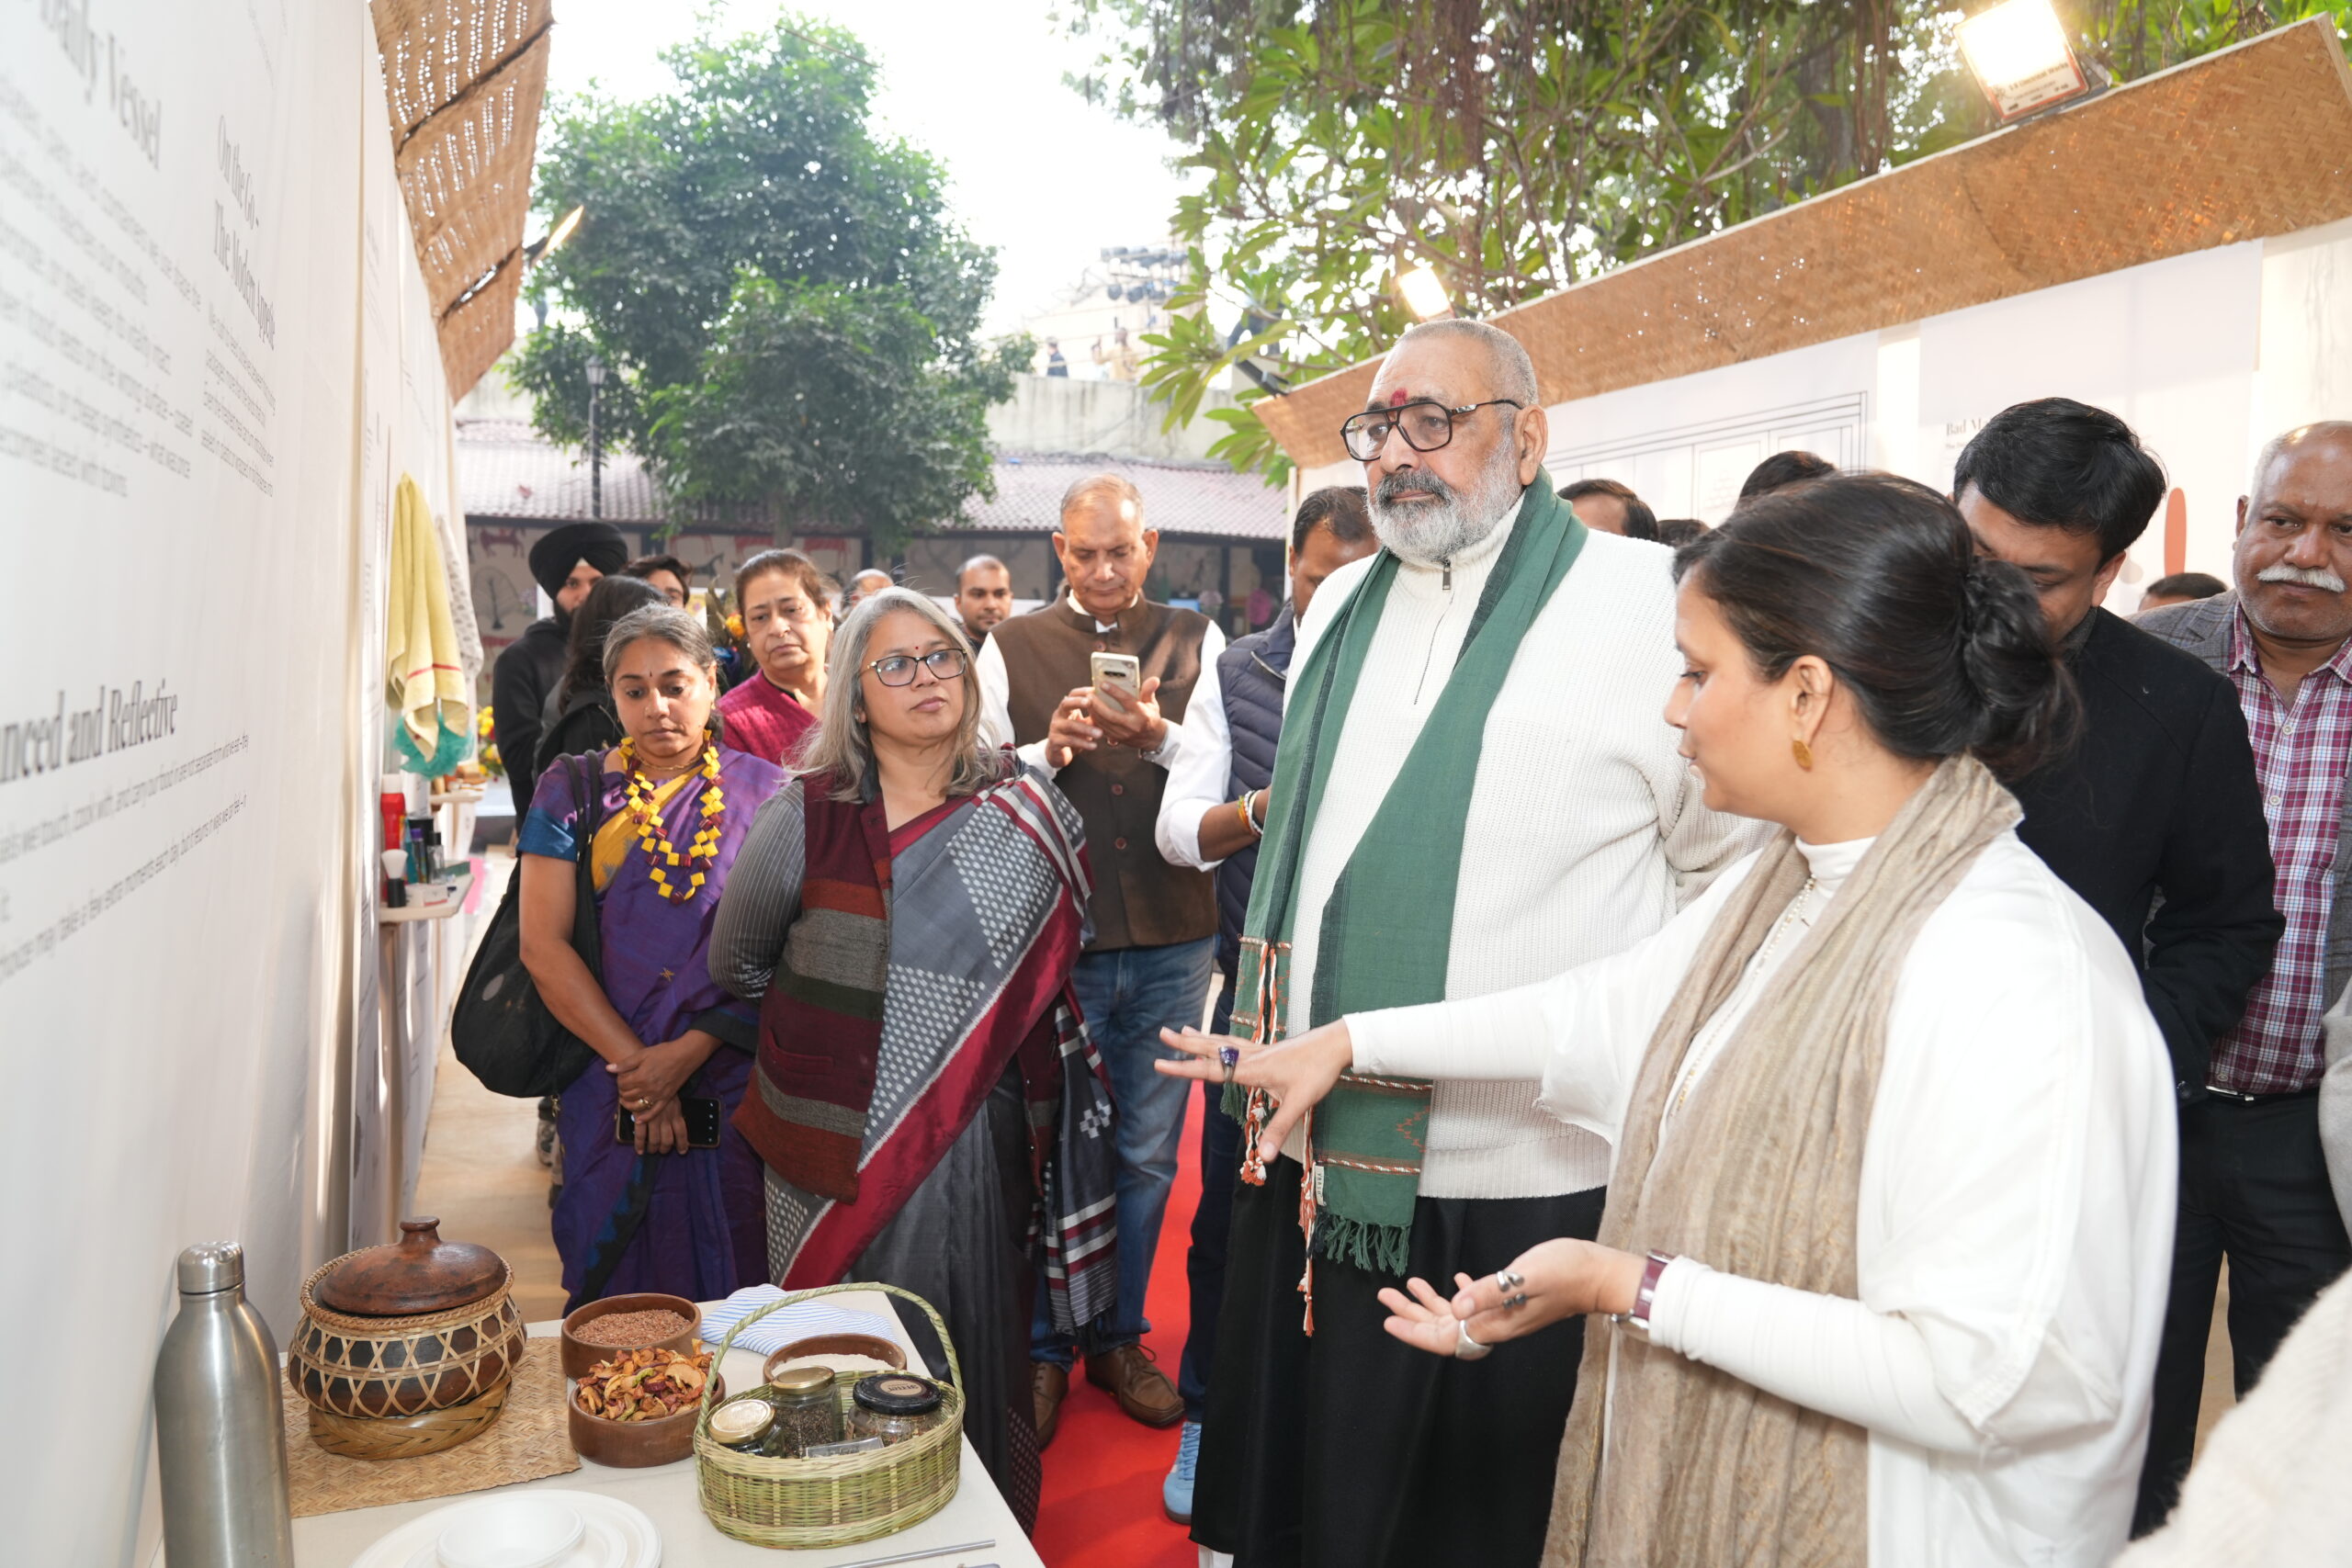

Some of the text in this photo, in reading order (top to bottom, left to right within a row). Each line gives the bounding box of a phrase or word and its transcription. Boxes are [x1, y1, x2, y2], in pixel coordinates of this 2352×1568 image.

[107, 30, 162, 172] Vessel
[217, 114, 231, 185] On
[231, 143, 244, 209] the
[243, 172, 255, 231] Go
[213, 197, 231, 272] The
[231, 229, 255, 318] Modern
[1945, 418, 1967, 436] Bad
[67, 685, 105, 764] and
[107, 679, 177, 756] Reflective
